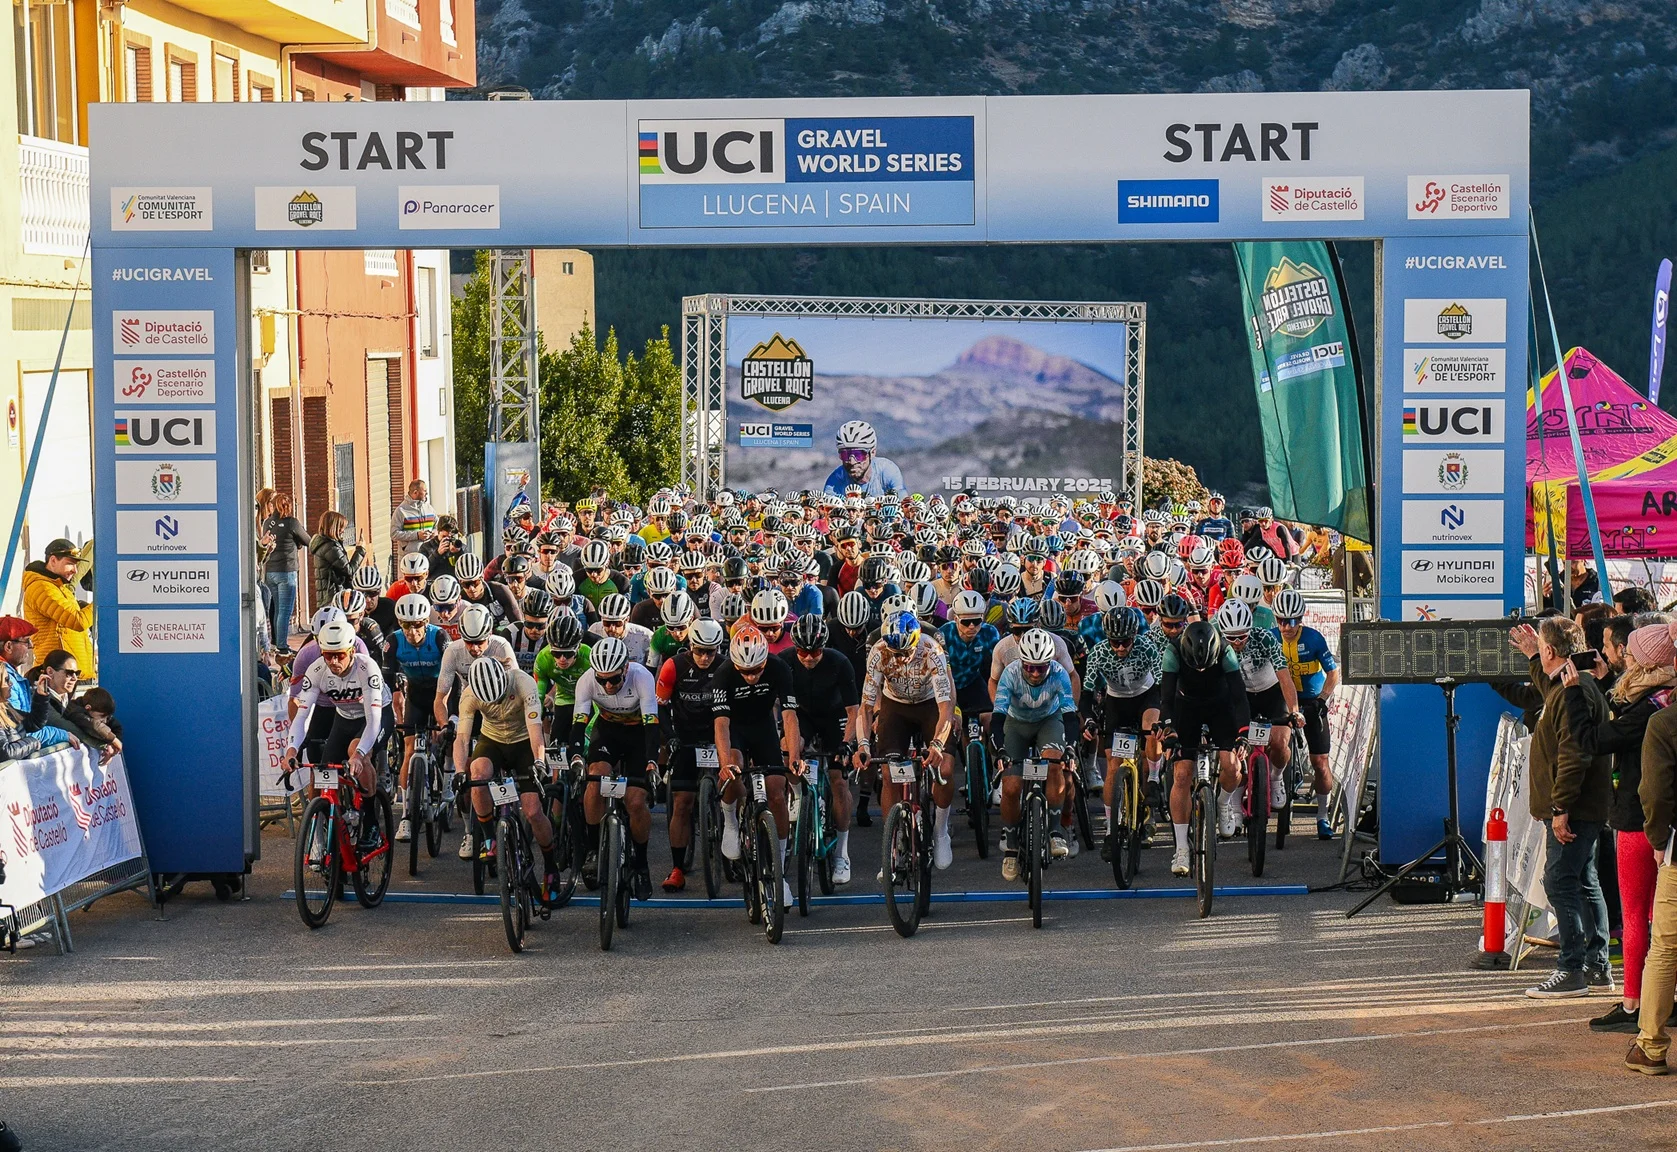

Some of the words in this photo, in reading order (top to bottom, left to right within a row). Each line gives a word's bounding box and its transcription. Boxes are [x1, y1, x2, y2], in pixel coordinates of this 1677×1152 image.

[797, 129, 887, 148] GRAVEL
[1163, 122, 1319, 163] START
[300, 131, 454, 171] START
[664, 130, 773, 174] UCI
[797, 154, 880, 173] WORLD
[886, 153, 962, 172] SERIES
[1451, 182, 1501, 193] Castellón
[1294, 188, 1352, 201] Diputació
[1451, 193, 1498, 203] Escenario
[137, 201, 197, 211] COMUNITAT
[703, 194, 816, 215] LLUCENA
[839, 193, 911, 214] SPAIN
[1127, 195, 1210, 208] SHIMANO
[1294, 200, 1309, 211] de
[1310, 199, 1358, 211] Castelló
[423, 200, 494, 215] Panaracer
[1451, 202, 1498, 213] Deportivo
[142, 210, 155, 219] DE
[1405, 256, 1507, 269] #UCIGRAVEL
[112, 268, 213, 281] #UCIGRAVEL
[145, 322, 202, 334] Diputació
[145, 334, 160, 344] de
[161, 333, 208, 344] Castelló
[744, 358, 811, 377] CASTELLÓN
[1430, 363, 1489, 372] COMUNITAT
[157, 368, 207, 378] Castellón
[1434, 373, 1448, 381] DE
[157, 378, 203, 388] Escenario
[744, 377, 782, 397] GRAVEL
[785, 378, 811, 398] RACE
[157, 388, 204, 398] Deportivo
[763, 396, 791, 405] LLUCENA
[1420, 407, 1491, 435] UCI
[131, 418, 202, 446] UCI
[746, 426, 770, 436] UCI
[942, 476, 962, 490] 15
[966, 476, 1060, 492] FEBRUARY
[1063, 478, 1112, 493] 2025
[1432, 533, 1472, 541] nutrinovex
[1437, 561, 1494, 570] HYUNDAI
[153, 570, 210, 580] HYUNDAI
[1436, 574, 1494, 583] Mobikorea
[153, 584, 209, 593] Mobikorea
[146, 623, 206, 631] GENERALITAT
[147, 632, 205, 640] VALENCIANA
[1255, 728, 1265, 738] 15
[1118, 739, 1130, 750] 16
[701, 750, 714, 759] 37
[323, 770, 330, 779] 8
[898, 767, 906, 775] 4
[499, 786, 507, 795] 9
[610, 783, 618, 791] 7
[756, 781, 763, 790] 5
[23, 795, 59, 831] Diputació
[38, 821, 68, 850] Castelló
